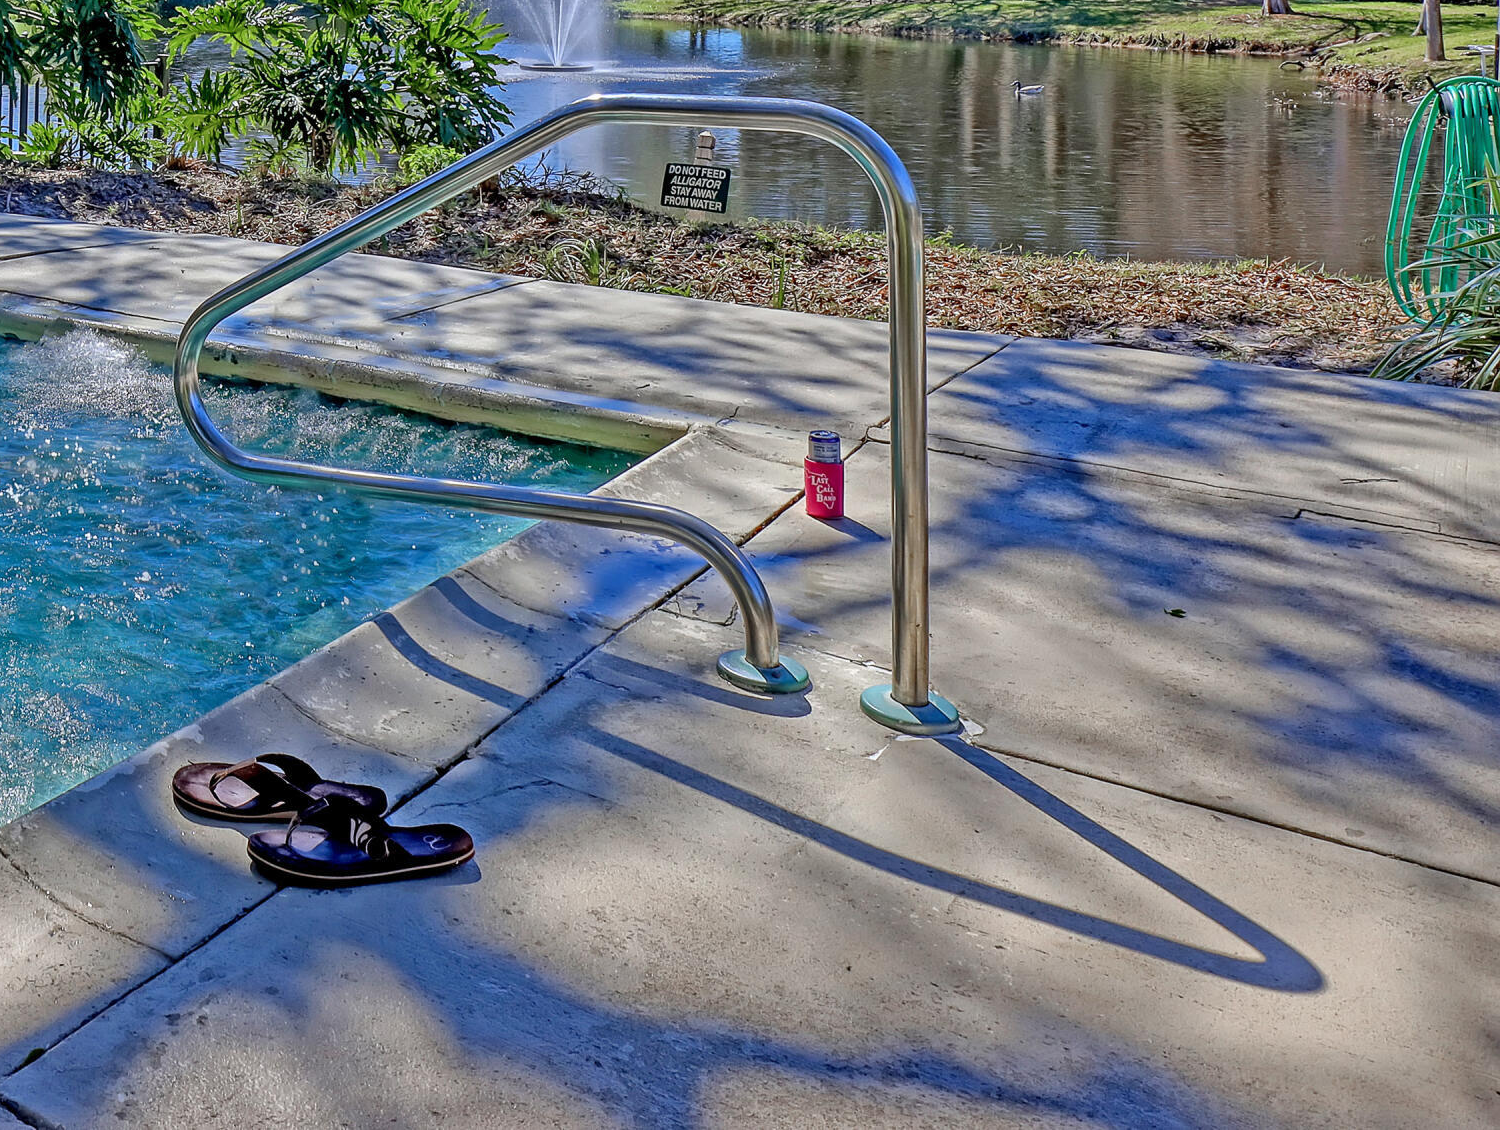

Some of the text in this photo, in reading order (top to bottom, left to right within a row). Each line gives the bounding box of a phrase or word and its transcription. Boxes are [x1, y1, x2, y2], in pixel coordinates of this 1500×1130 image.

[669, 165, 726, 179] DO NOT FEED
[671, 176, 721, 189] ALLIGATOR
[671, 186, 718, 200] STAY AWAY
[664, 195, 722, 211] FROM WATER
